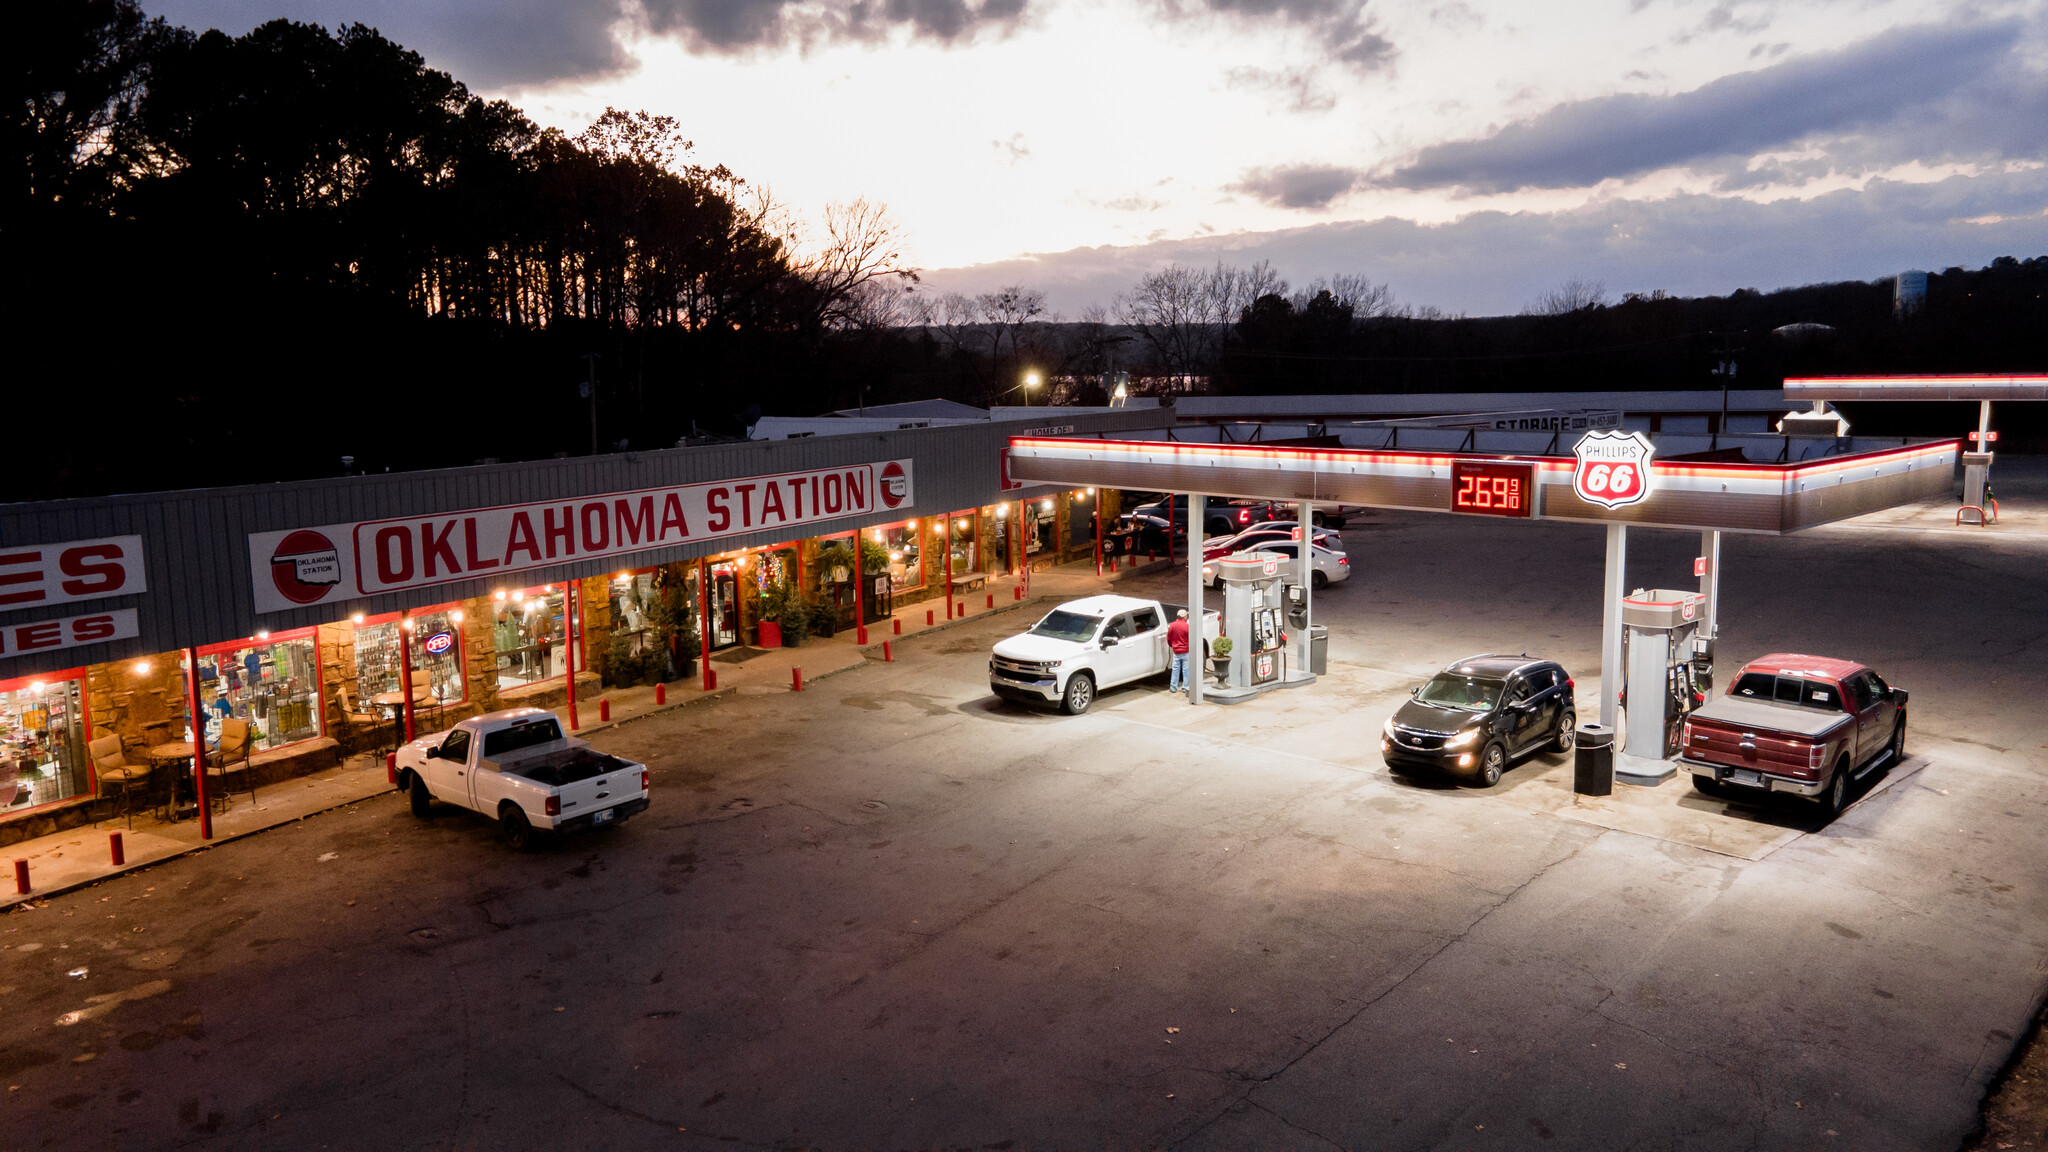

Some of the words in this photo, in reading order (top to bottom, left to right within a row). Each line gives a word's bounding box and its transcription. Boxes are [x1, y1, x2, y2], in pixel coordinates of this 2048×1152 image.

[1586, 446, 1637, 458] PHILLIPS
[1587, 464, 1633, 493] 66
[1457, 476, 1508, 509] 2.69
[375, 492, 690, 585] OKLAHOMA
[706, 469, 865, 533] STATION
[1294, 531, 1299, 539] 2
[297, 555, 336, 566] OKLAHOMA
[1698, 562, 1703, 571] 4
[302, 565, 332, 575] STATION
[0, 615, 115, 655] ES
[426, 634, 452, 651] OPEN
